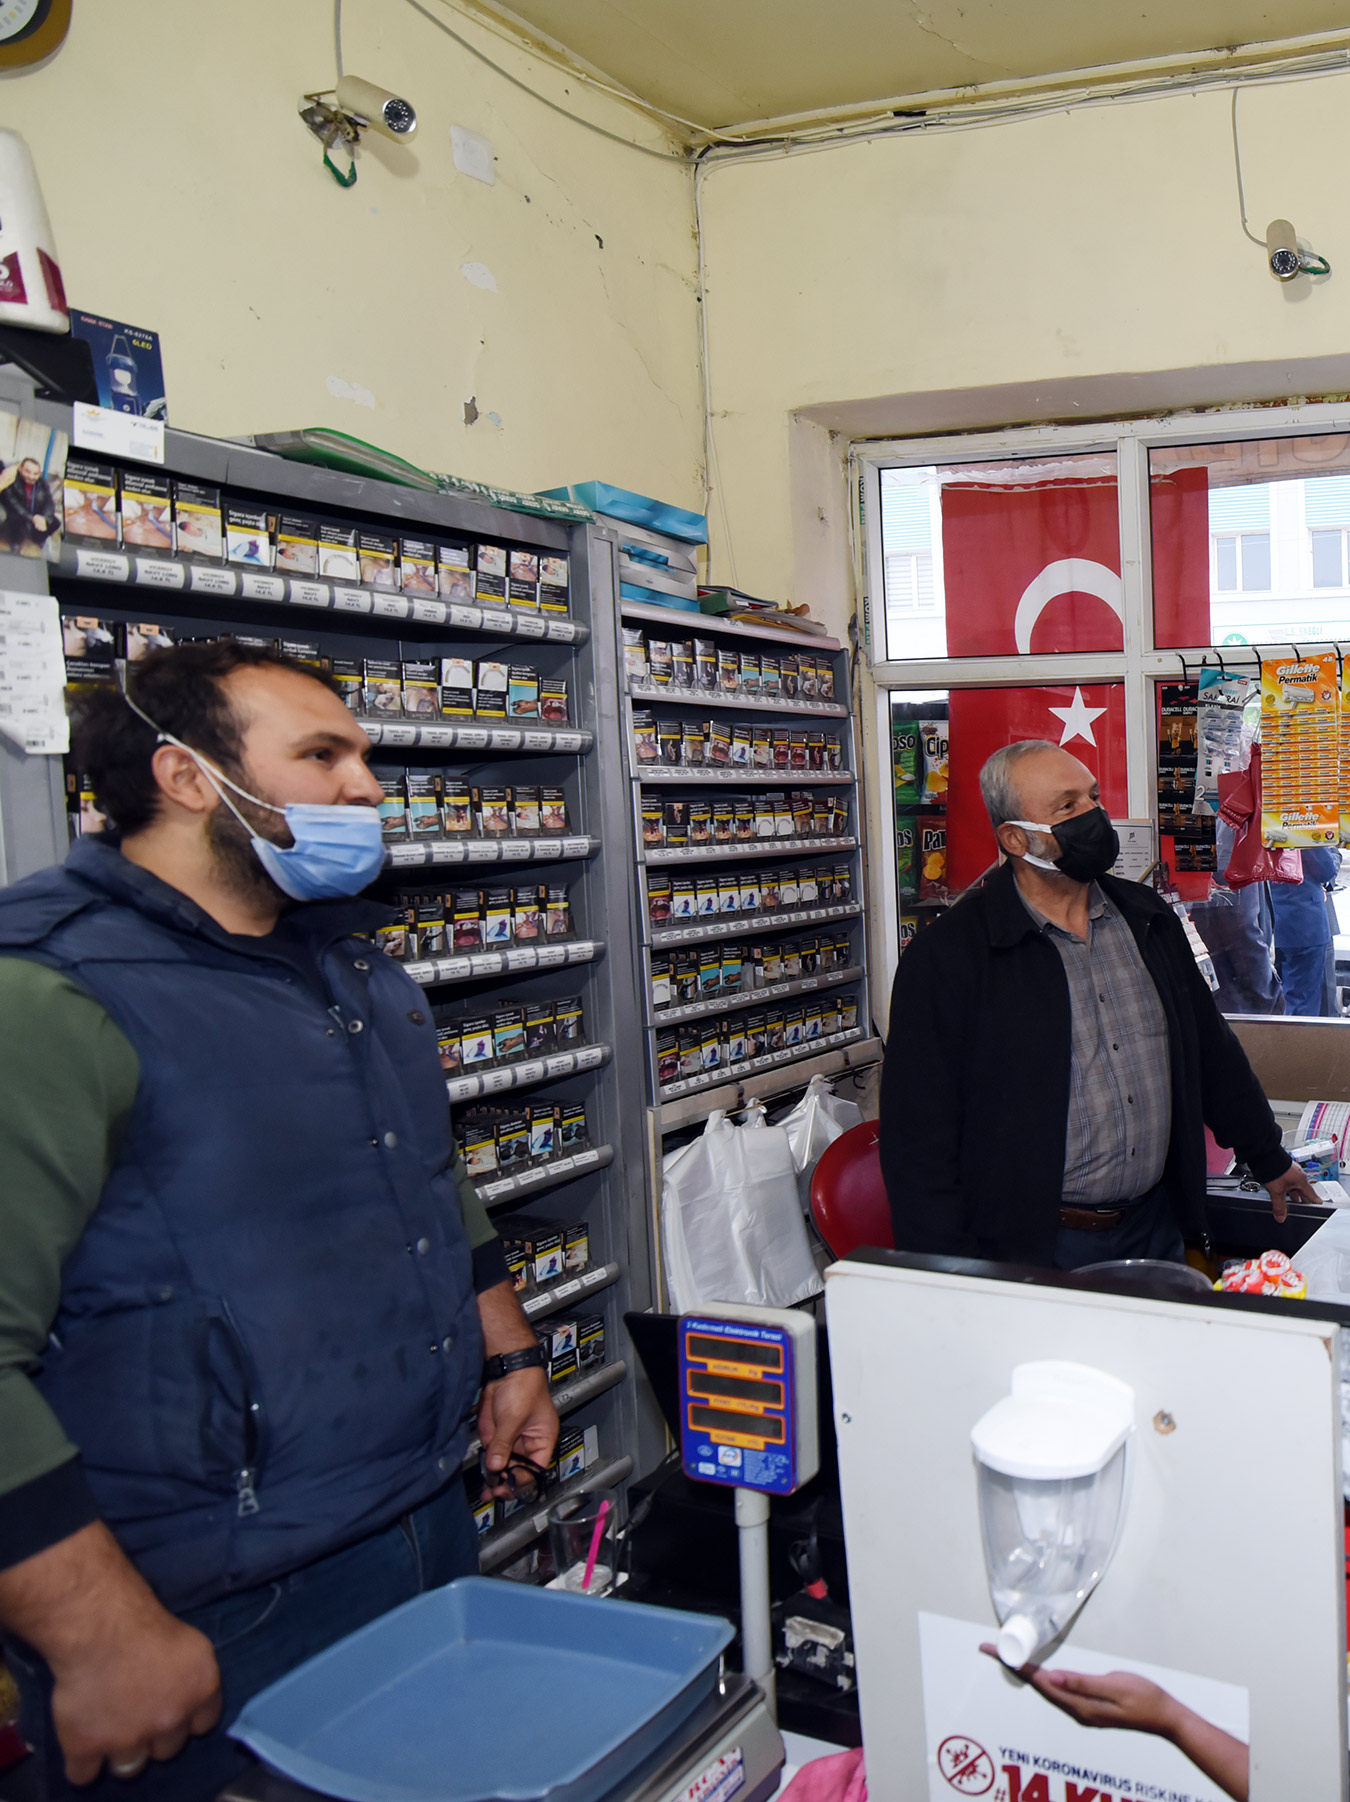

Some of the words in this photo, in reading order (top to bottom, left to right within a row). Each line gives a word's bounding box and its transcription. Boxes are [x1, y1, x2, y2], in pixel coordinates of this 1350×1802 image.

[1276, 663, 1320, 675] Gillette
[1278, 673, 1318, 684] Permatik
[926, 736, 948, 757] Cip
[1280, 812, 1320, 822] Gillette
